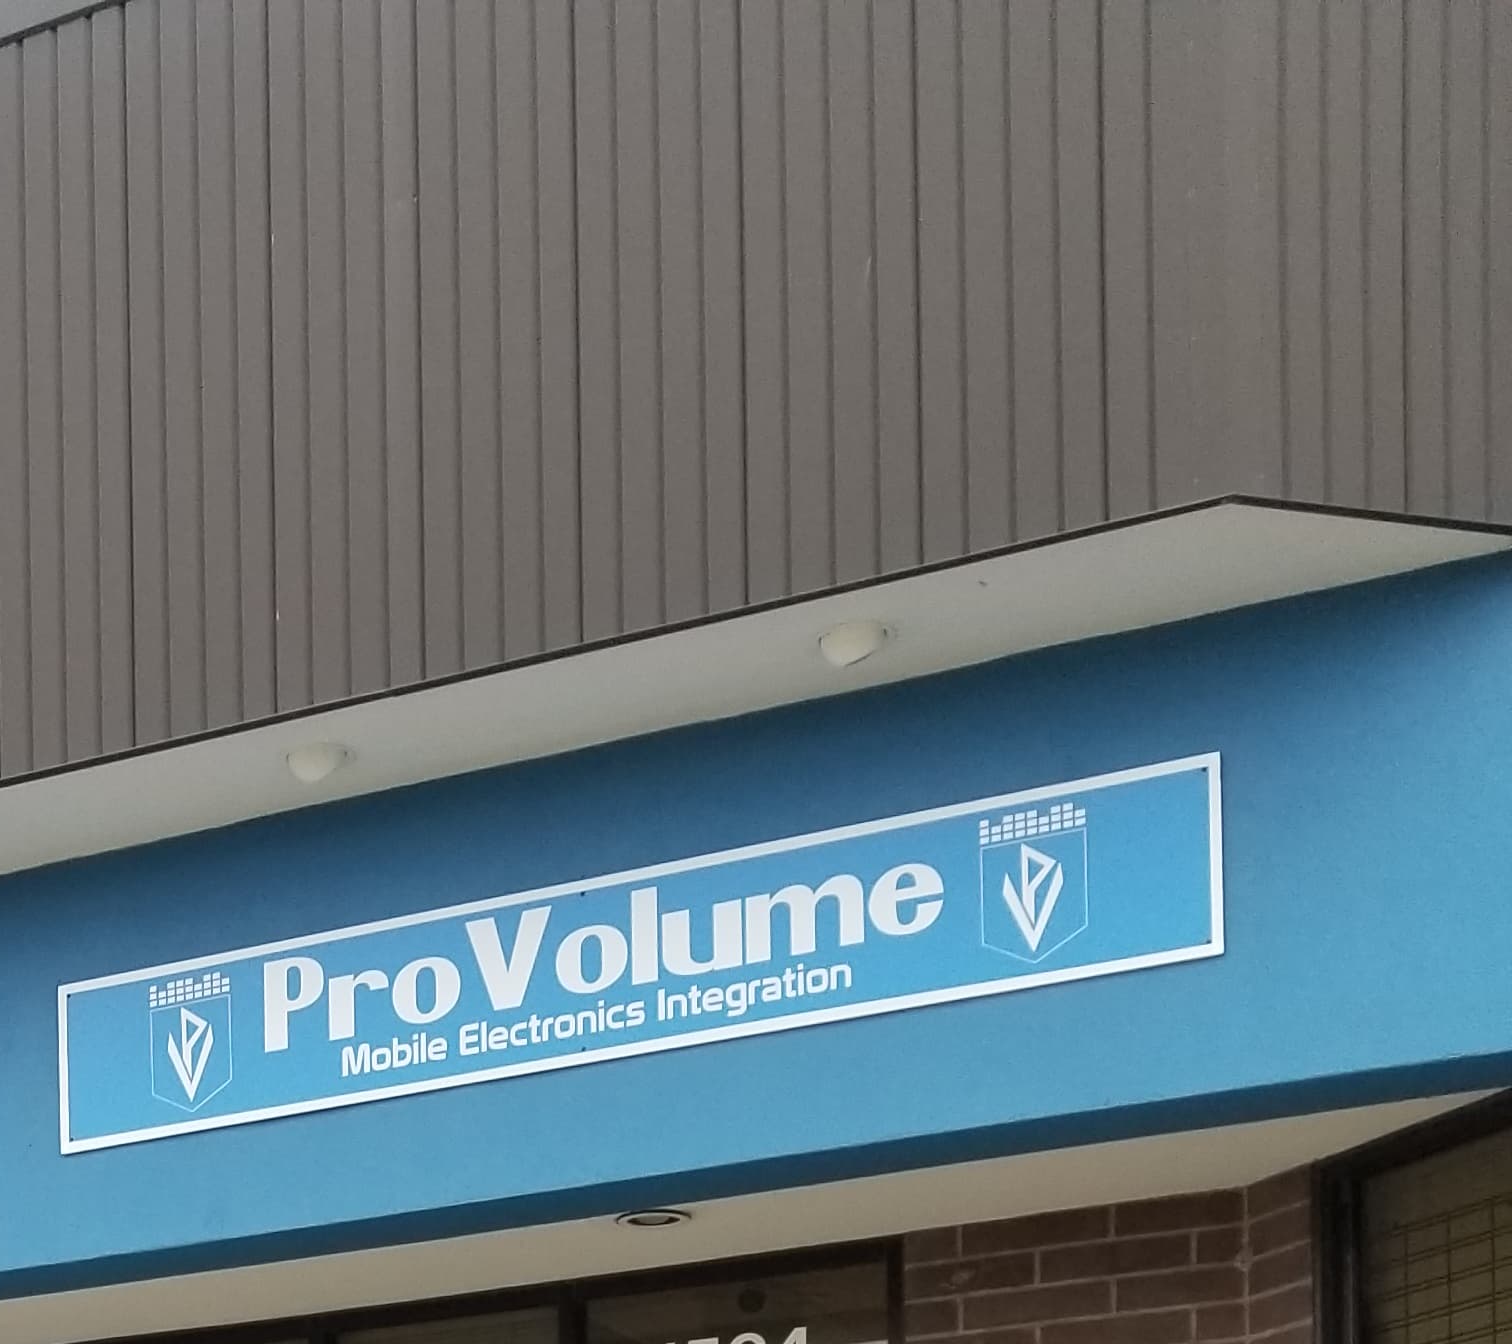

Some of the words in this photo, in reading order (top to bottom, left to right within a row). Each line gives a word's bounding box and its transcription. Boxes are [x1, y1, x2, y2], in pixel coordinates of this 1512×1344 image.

[263, 863, 944, 1053] ProVolume
[342, 1033, 448, 1077] Mobile
[459, 1000, 645, 1056] Electronics
[658, 962, 852, 1022] Integration
